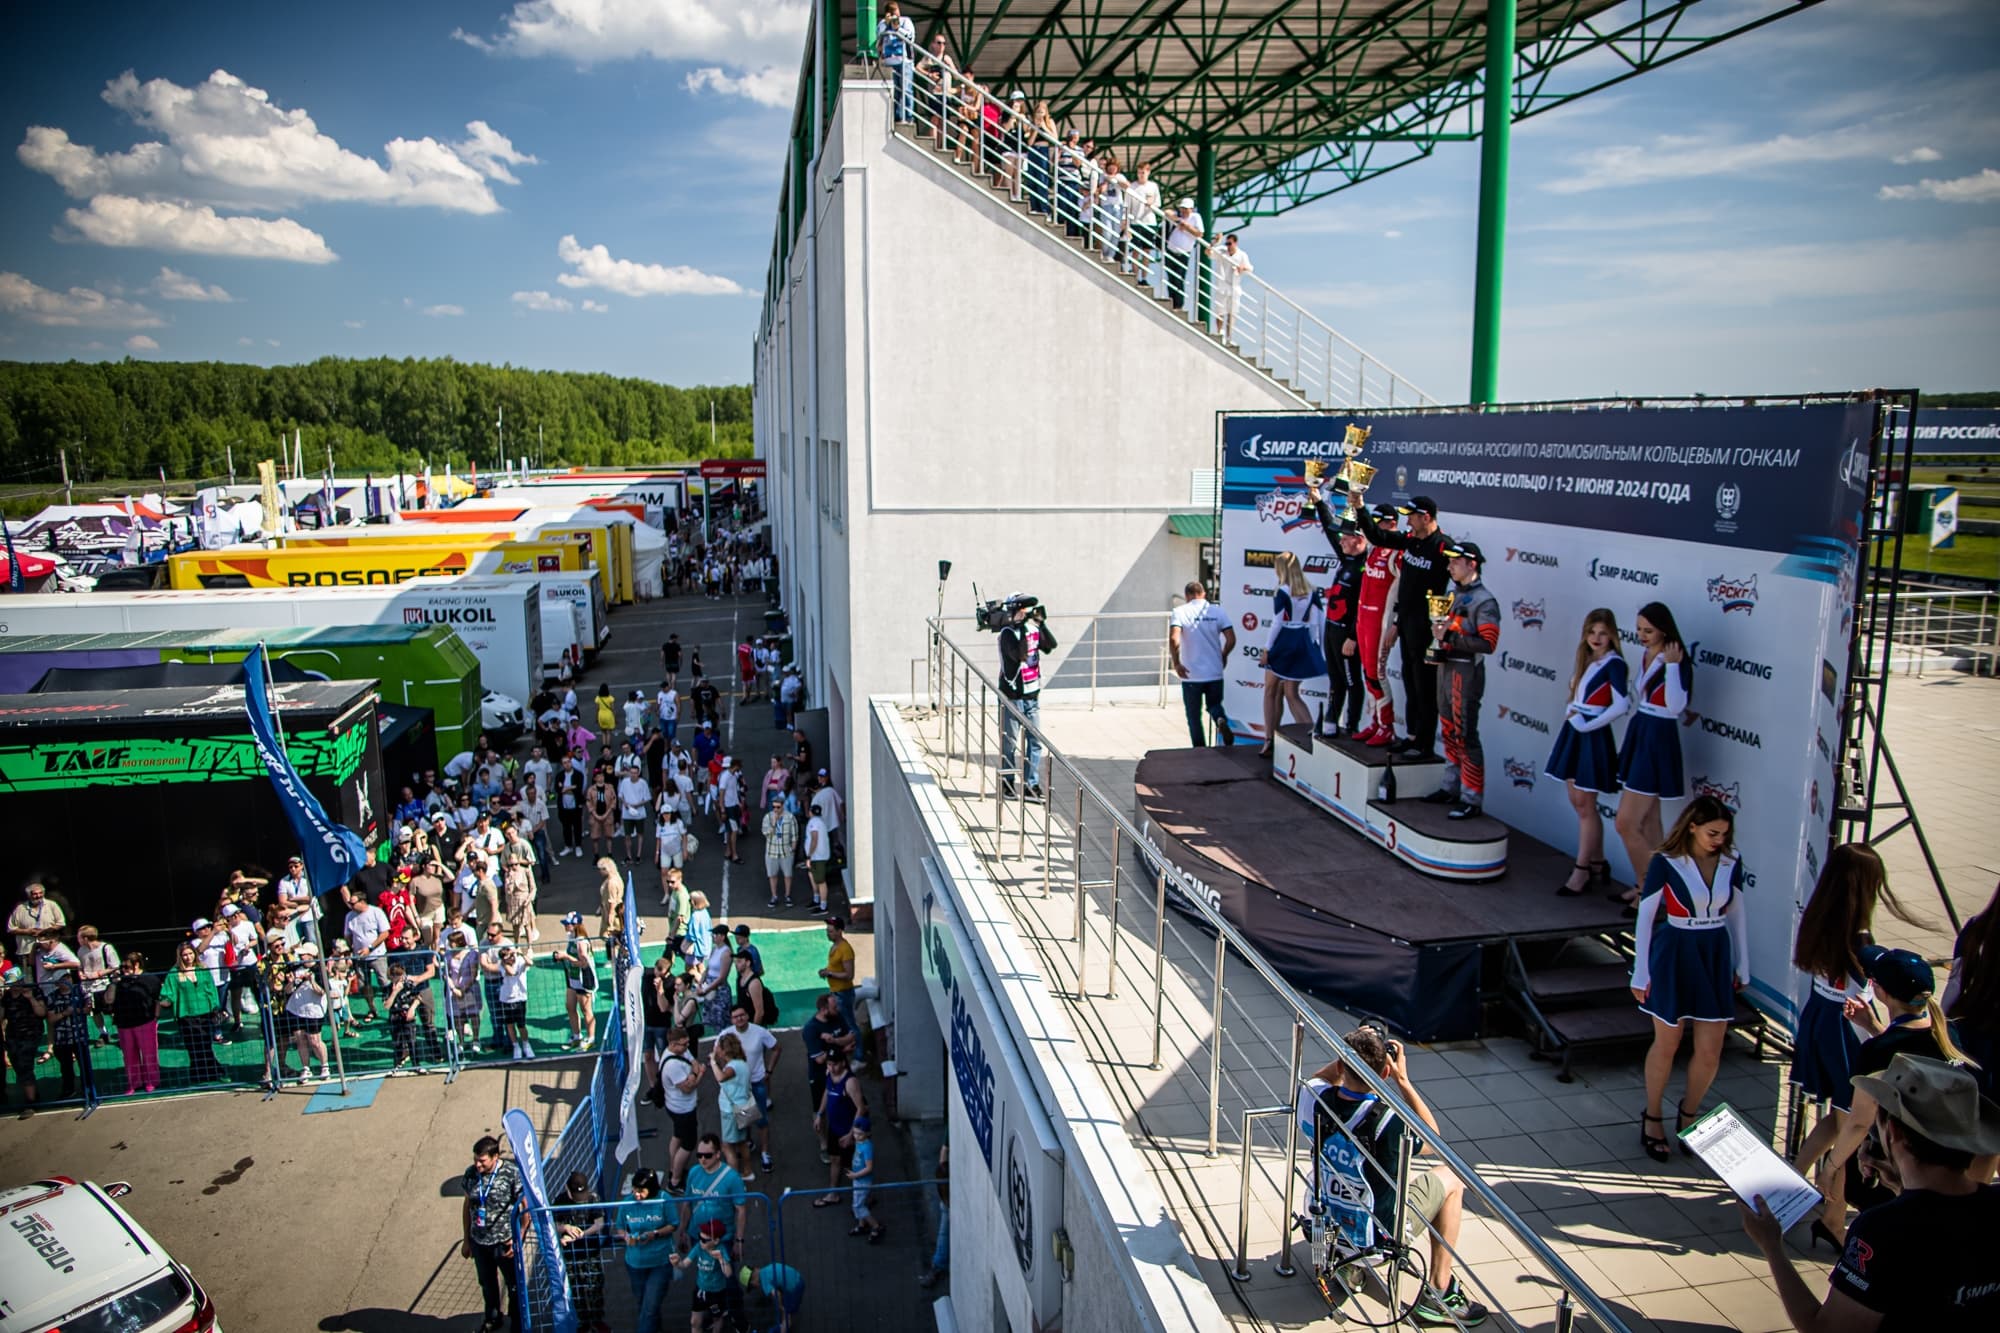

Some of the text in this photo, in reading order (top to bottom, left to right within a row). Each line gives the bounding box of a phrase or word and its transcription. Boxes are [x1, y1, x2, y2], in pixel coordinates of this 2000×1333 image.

[1261, 440, 1345, 456] SMP RACIN
[1396, 441, 1449, 455] ЧЕМПИОНАТА
[1457, 442, 1483, 457] КУБКА
[1484, 443, 1521, 458] РОССИИ
[1522, 443, 1539, 458] ПО
[1539, 443, 1643, 461] АВТОМОБИЛЬНЫМ
[1643, 445, 1731, 467] КОЛЬЦЕВЫМ
[1732, 447, 1800, 467] ГОНКАМ
[1418, 469, 1501, 488] НИЖЕГОРОДСКОЕ
[1502, 473, 1547, 492] КОЛЬЦО
[1556, 476, 1574, 492] 1-2
[1574, 477, 1615, 496] ИЮНЯ
[1615, 480, 1649, 498] 2024
[1649, 482, 1691, 504] ГОДА
[1273, 500, 1303, 516] РС
[1518, 551, 1559, 569] YOKOHAMA
[1599, 564, 1659, 586] SMP RACING
[463, 596, 487, 605] TEAM
[554, 589, 586, 597] LUKOIL
[424, 607, 497, 624] LUKOIL
[1508, 657, 1557, 682] SMP RACING
[1699, 649, 1773, 680] SMP RACING
[1700, 716, 1762, 749] YOKOHAMA
[39, 747, 187, 773] TAIF MOTORSPORT
[1288, 753, 1296, 779] 2
[1334, 772, 1342, 800] 1
[1386, 821, 1396, 850] 3
[952, 975, 995, 1121] RACING
